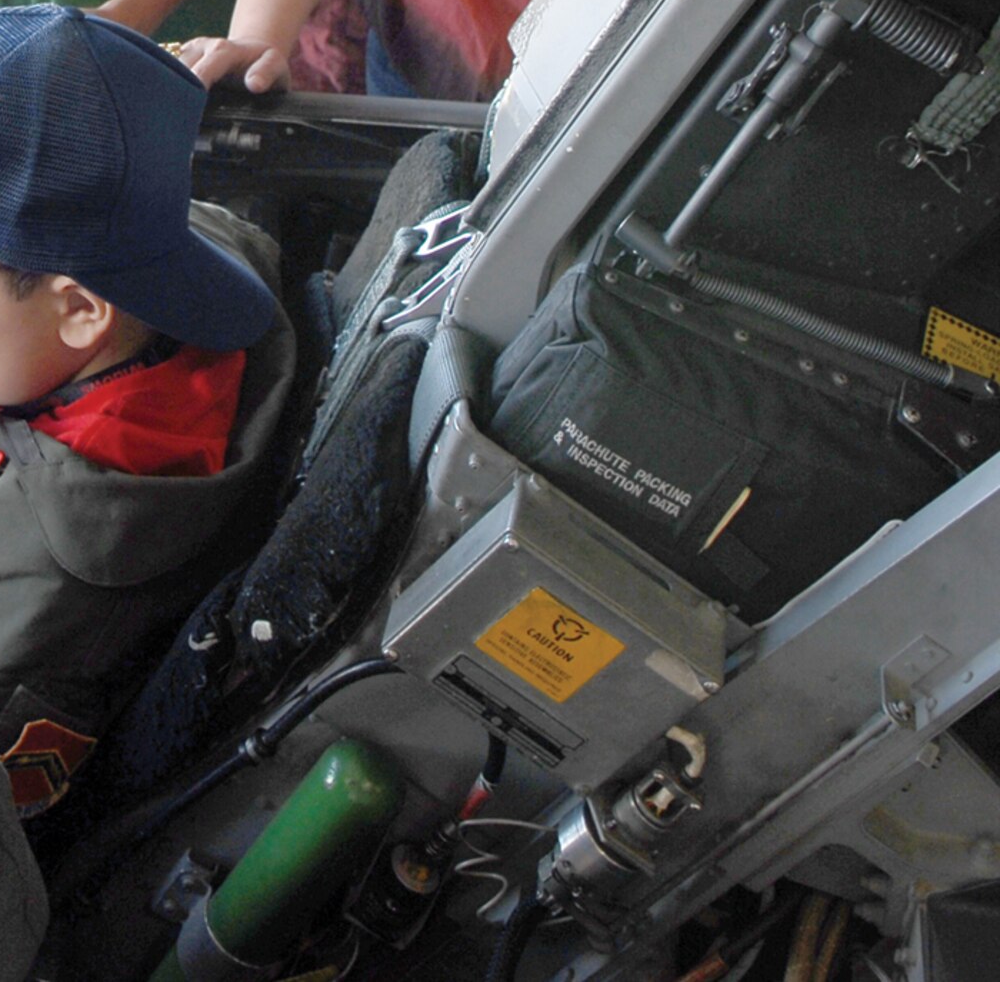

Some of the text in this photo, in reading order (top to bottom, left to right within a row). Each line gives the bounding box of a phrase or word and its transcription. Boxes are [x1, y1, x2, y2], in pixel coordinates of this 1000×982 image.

[553, 431, 680, 517] & INSPECTION DATA
[561, 418, 691, 506] PARACHUTE PACKING
[526, 627, 574, 663] CAUTION
